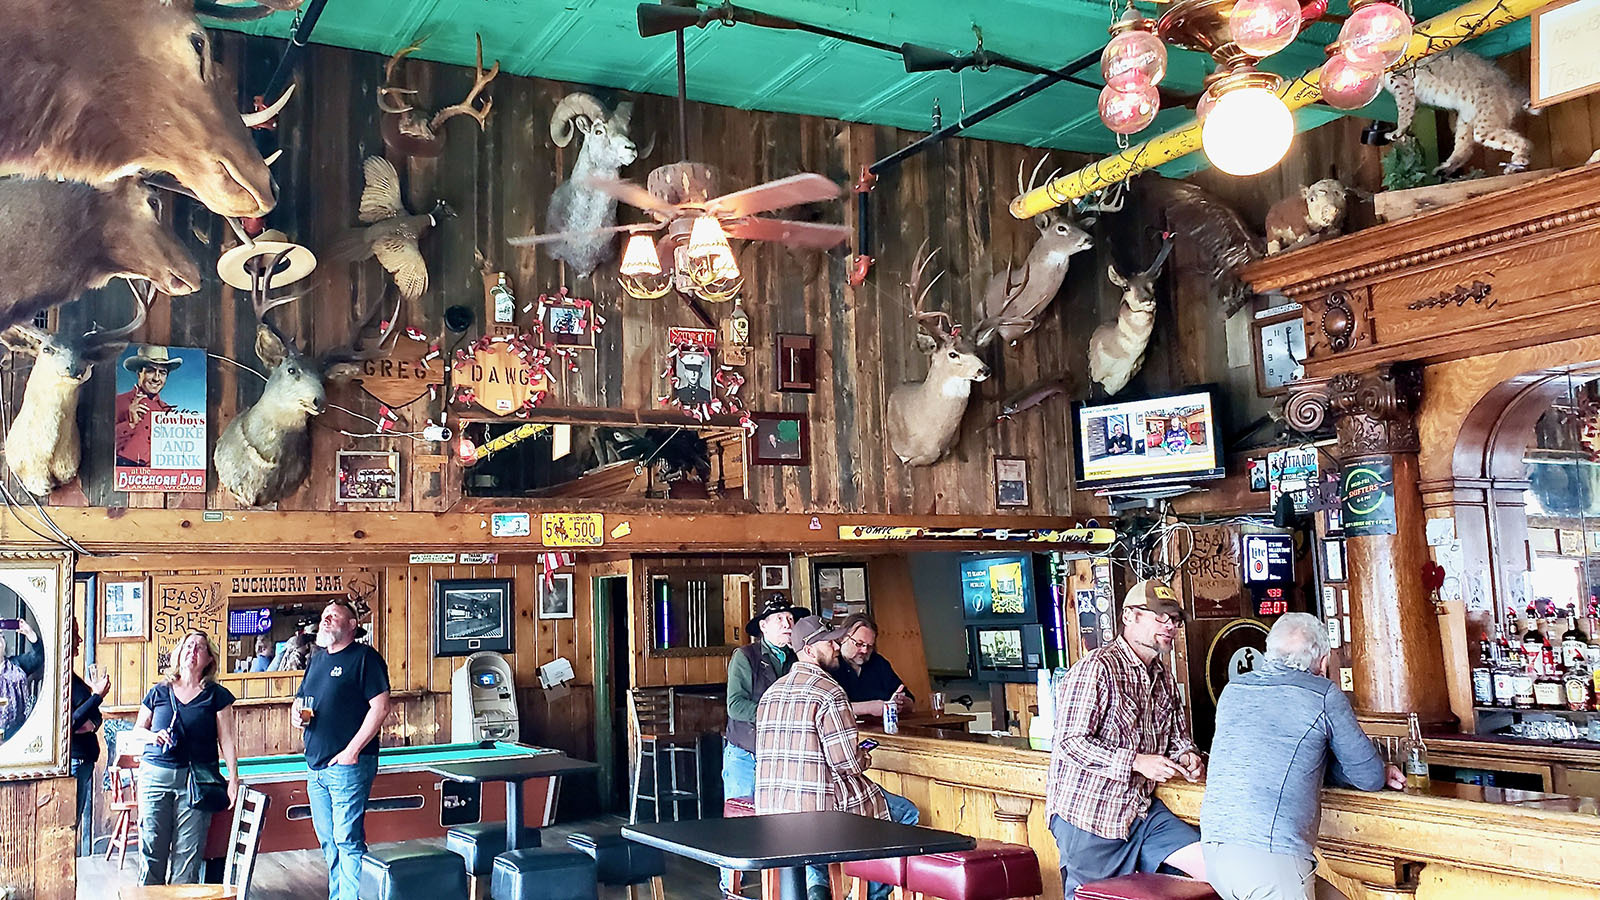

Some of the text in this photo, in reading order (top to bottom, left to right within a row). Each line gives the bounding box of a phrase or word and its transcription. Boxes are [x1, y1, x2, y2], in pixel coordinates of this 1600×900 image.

[471, 364, 530, 386] DAWG
[155, 414, 205, 428] Cowboys
[153, 426, 204, 439] SMOKE
[162, 440, 195, 453] AND
[155, 454, 201, 466] DRINK
[140, 467, 151, 475] the
[118, 472, 203, 488] BUCKHORN BAR
[545, 521, 596, 538] 5 500
[1251, 547, 1266, 559] Lite
[1188, 553, 1240, 579] STREET
[231, 576, 343, 593] BUCKHORN BAR
[162, 586, 209, 610] EASY
[155, 611, 223, 635] STREET
